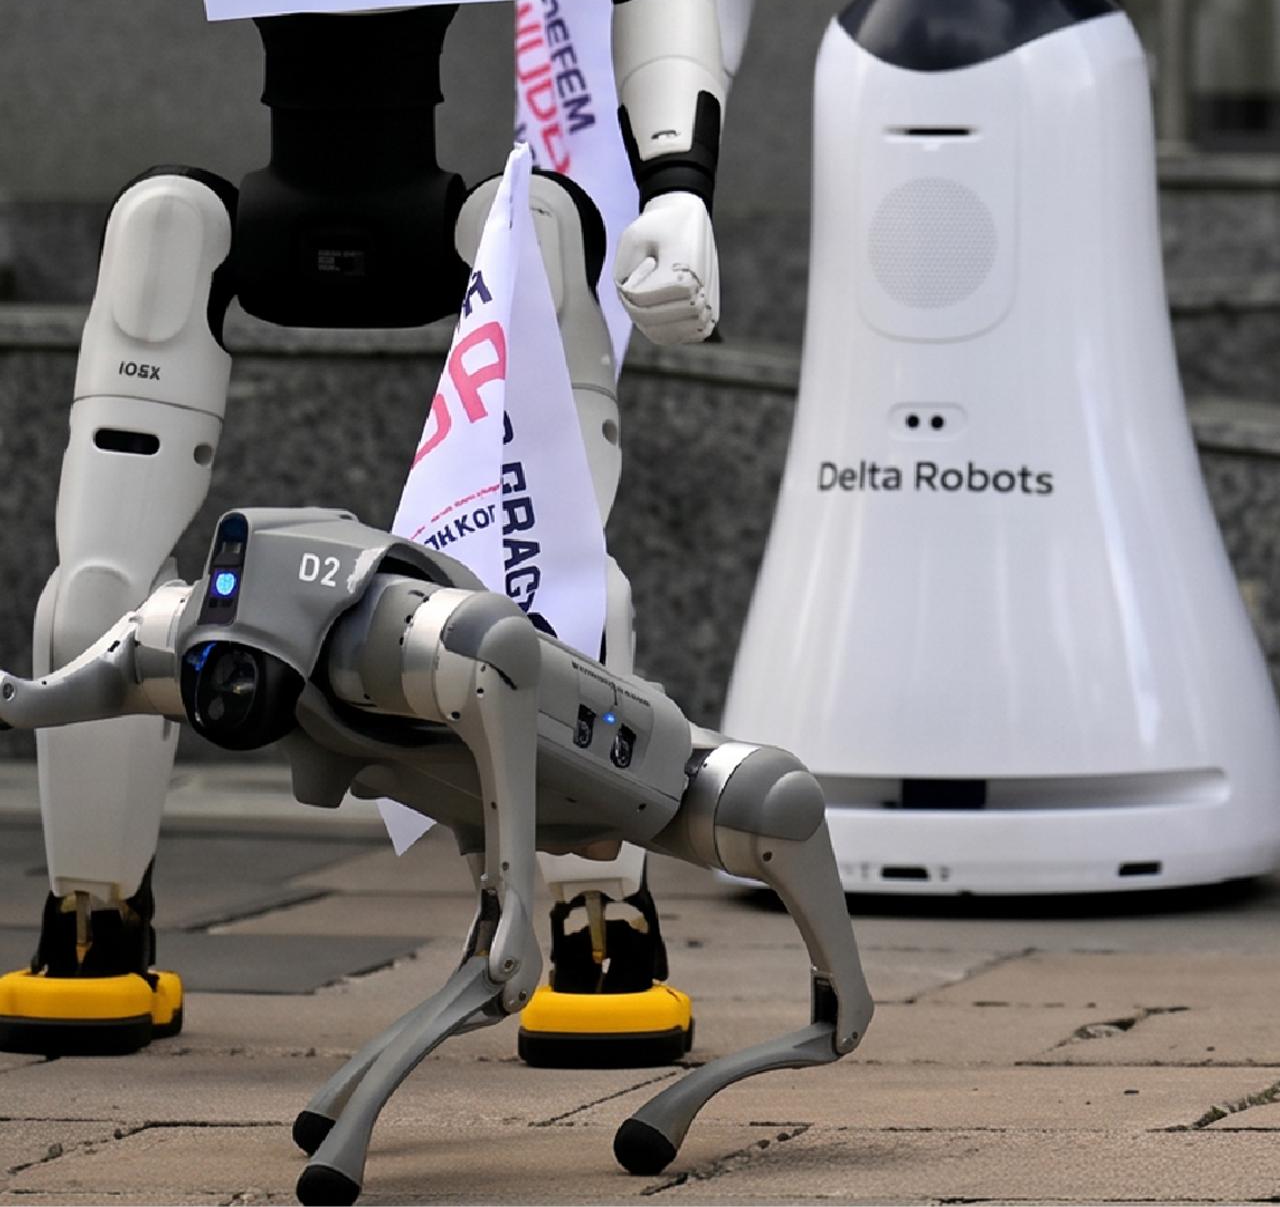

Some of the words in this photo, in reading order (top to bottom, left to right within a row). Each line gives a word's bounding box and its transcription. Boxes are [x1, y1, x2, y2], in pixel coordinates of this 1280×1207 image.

[818, 459, 903, 492] Delta
[914, 460, 1055, 496] Robots
[299, 552, 340, 588] D2
